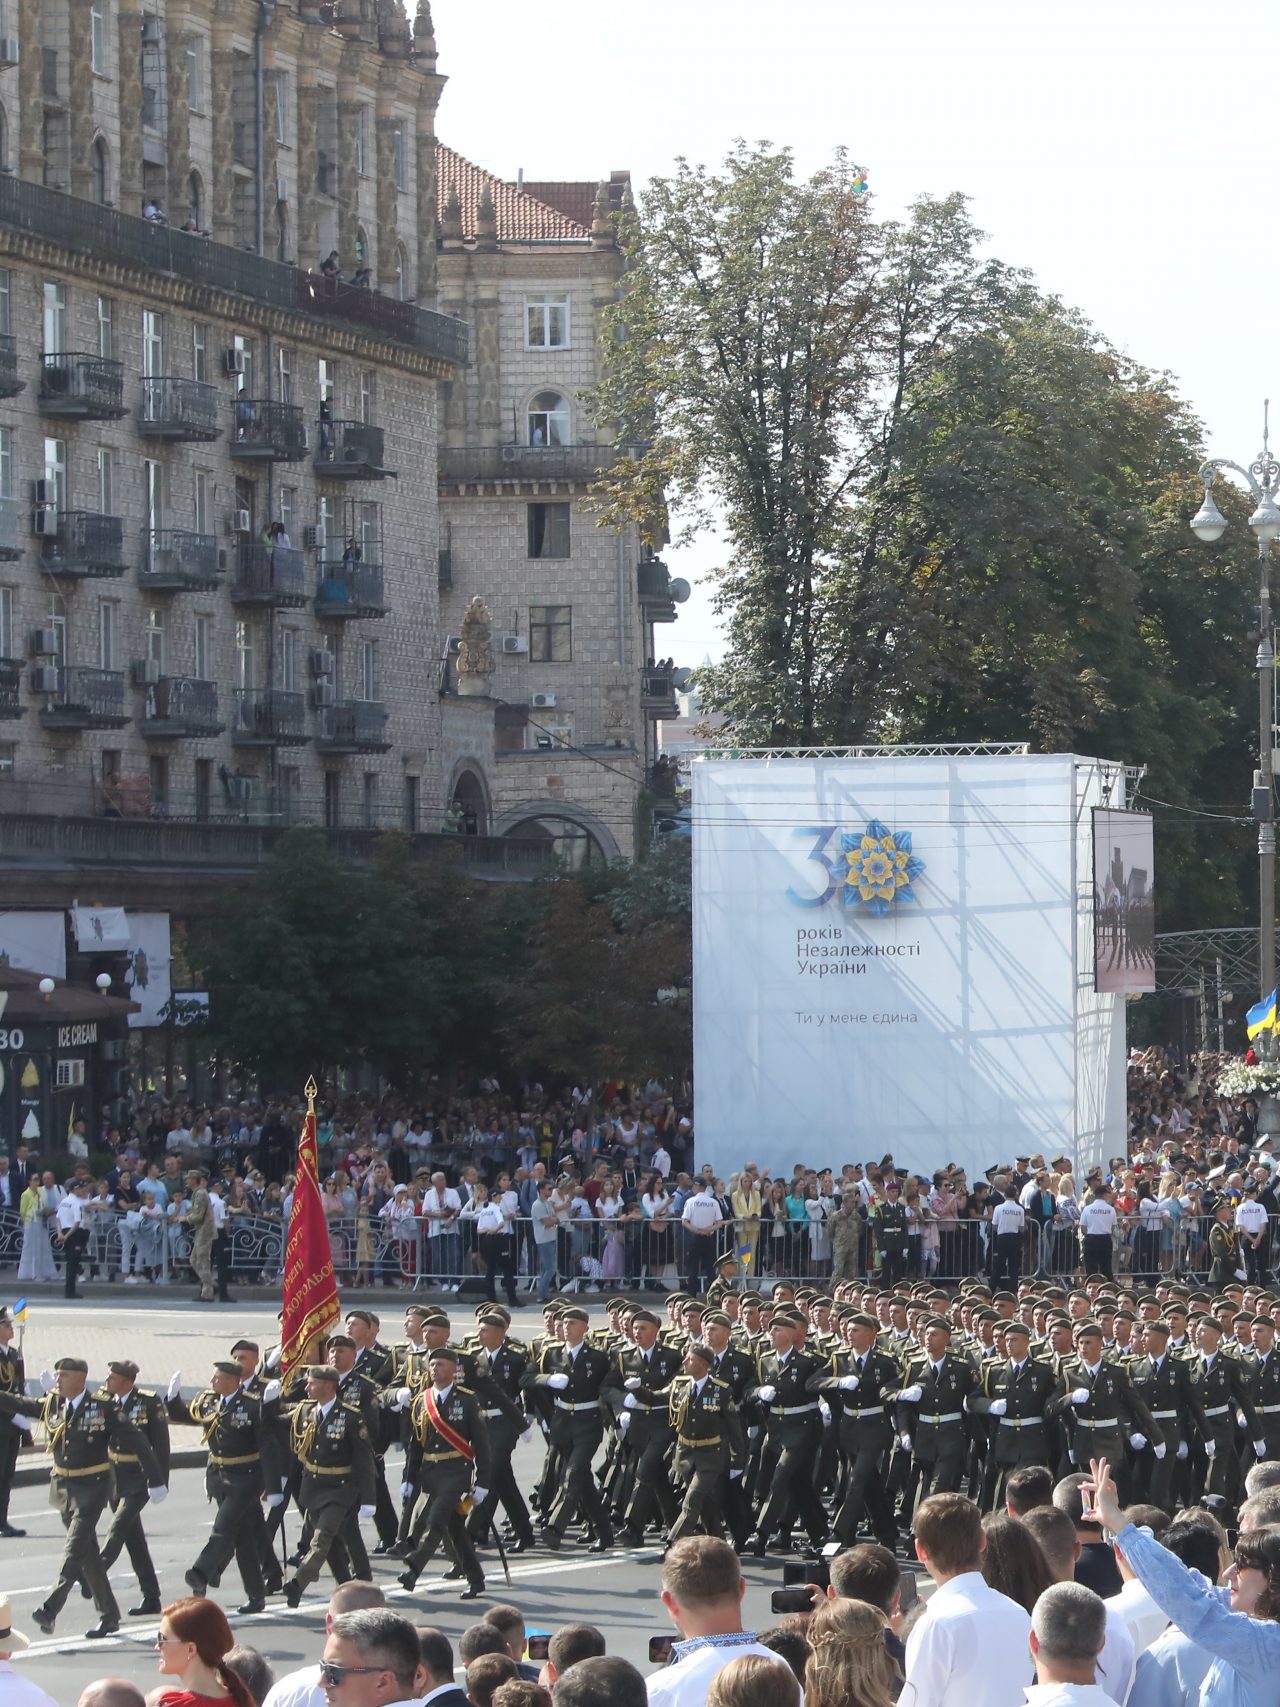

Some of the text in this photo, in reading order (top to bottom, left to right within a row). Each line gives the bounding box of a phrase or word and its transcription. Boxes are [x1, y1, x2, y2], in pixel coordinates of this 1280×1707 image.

[797, 924, 842, 942] років
[797, 941, 920, 957] Незалежності
[797, 960, 866, 979] України
[794, 1012, 918, 1027] Ти у мене єдина
[58, 1022, 98, 1049] ICE CREAM
[284, 1257, 304, 1292] ІМЕНІ
